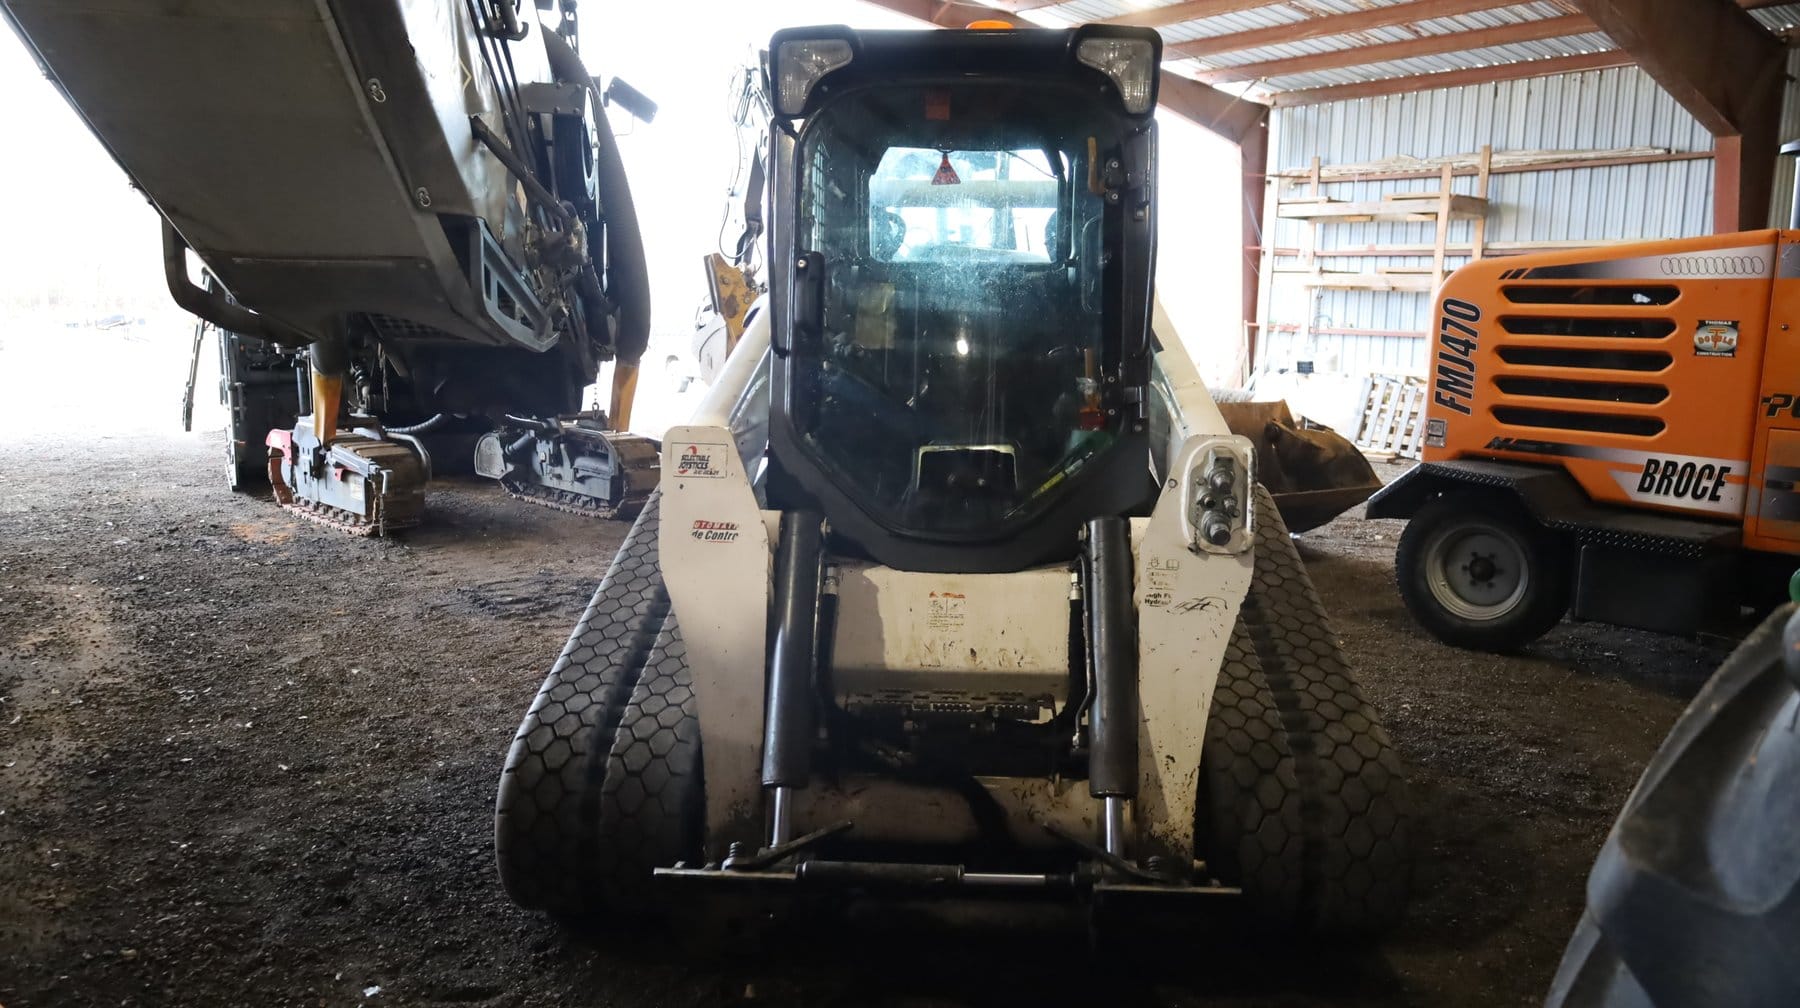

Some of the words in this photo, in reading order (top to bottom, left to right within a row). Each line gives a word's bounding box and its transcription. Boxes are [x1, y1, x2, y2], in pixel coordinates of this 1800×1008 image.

[1435, 298, 1481, 415] FMJ470
[678, 461, 709, 470] JOYSTICKS
[1637, 458, 1732, 501] BROCE
